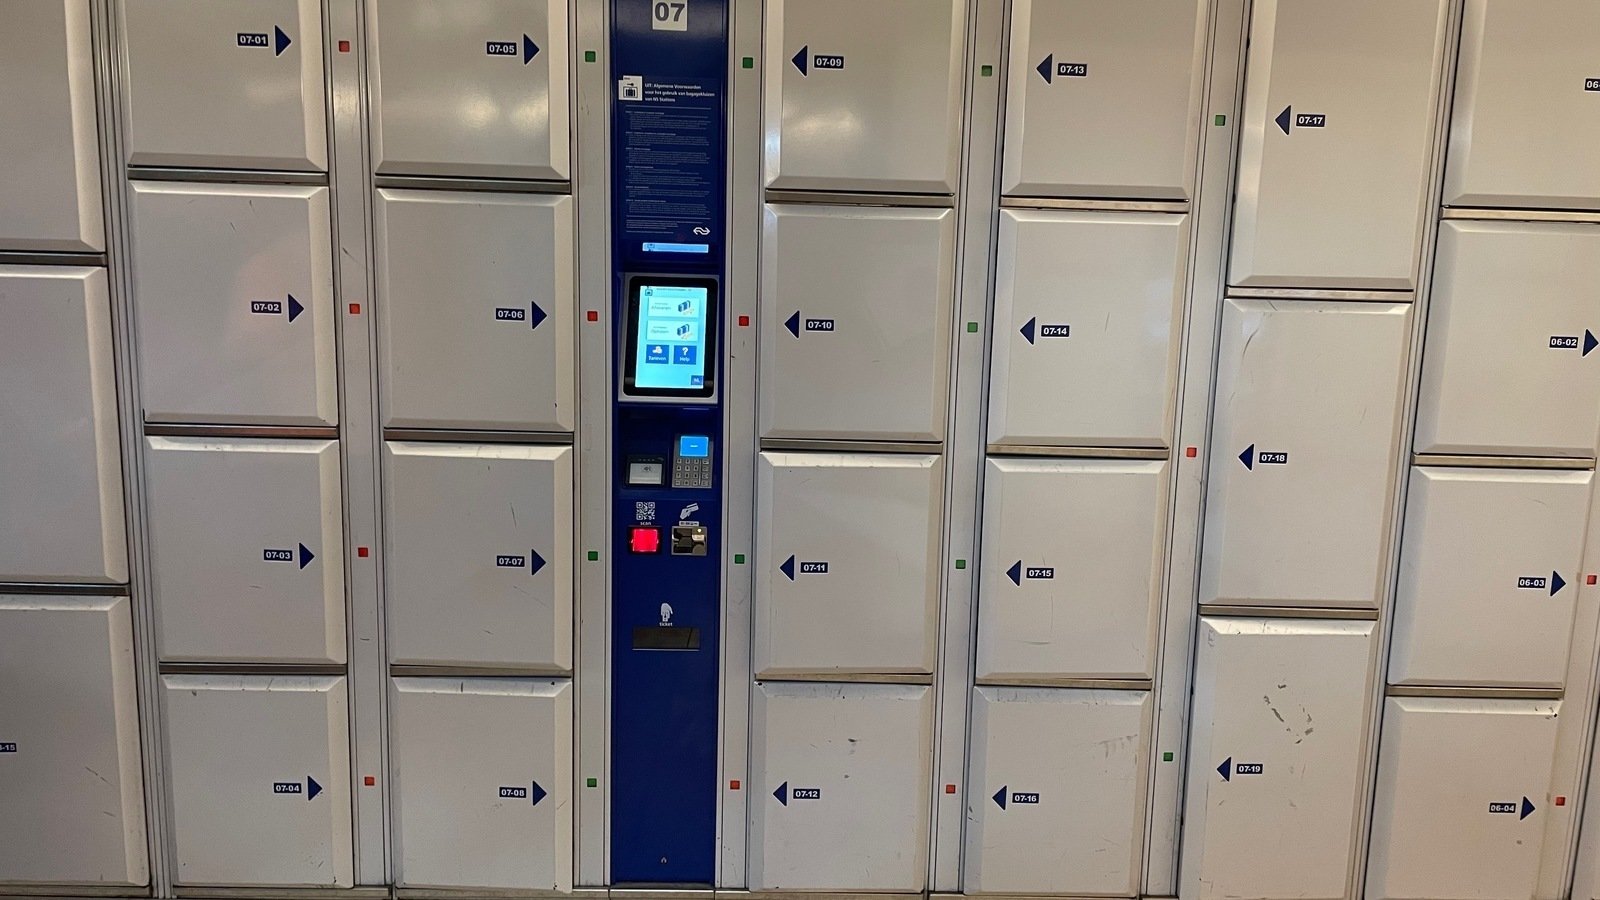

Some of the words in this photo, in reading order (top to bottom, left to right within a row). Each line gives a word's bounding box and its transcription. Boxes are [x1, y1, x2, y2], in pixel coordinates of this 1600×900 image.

[654, 2, 685, 22] 07
[239, 35, 268, 45] 07-01
[489, 44, 516, 54] 07-05
[815, 57, 842, 67] 07-09
[1060, 65, 1086, 75] 07-13
[1298, 116, 1324, 125] 07-17
[253, 303, 280, 312] 07-02
[497, 310, 524, 320] 07-06
[807, 320, 833, 330] 07-10
[1042, 327, 1068, 336] 07-14
[1550, 338, 1577, 347] 06-02
[1261, 453, 1287, 463] 07-18
[265, 551, 291, 560] 07-03
[498, 557, 524, 566] 07-07
[802, 563, 827, 572] 07-11
[1028, 569, 1053, 578] 07-15
[1519, 578, 1545, 587] 06-03
[1238, 764, 1262, 773] 07-19
[275, 784, 300, 793] 07-04
[500, 788, 525, 798] 07-08
[794, 790, 819, 799] 07-12
[1013, 794, 1038, 803] 07-16
[1489, 804, 1515, 813] 06-04
